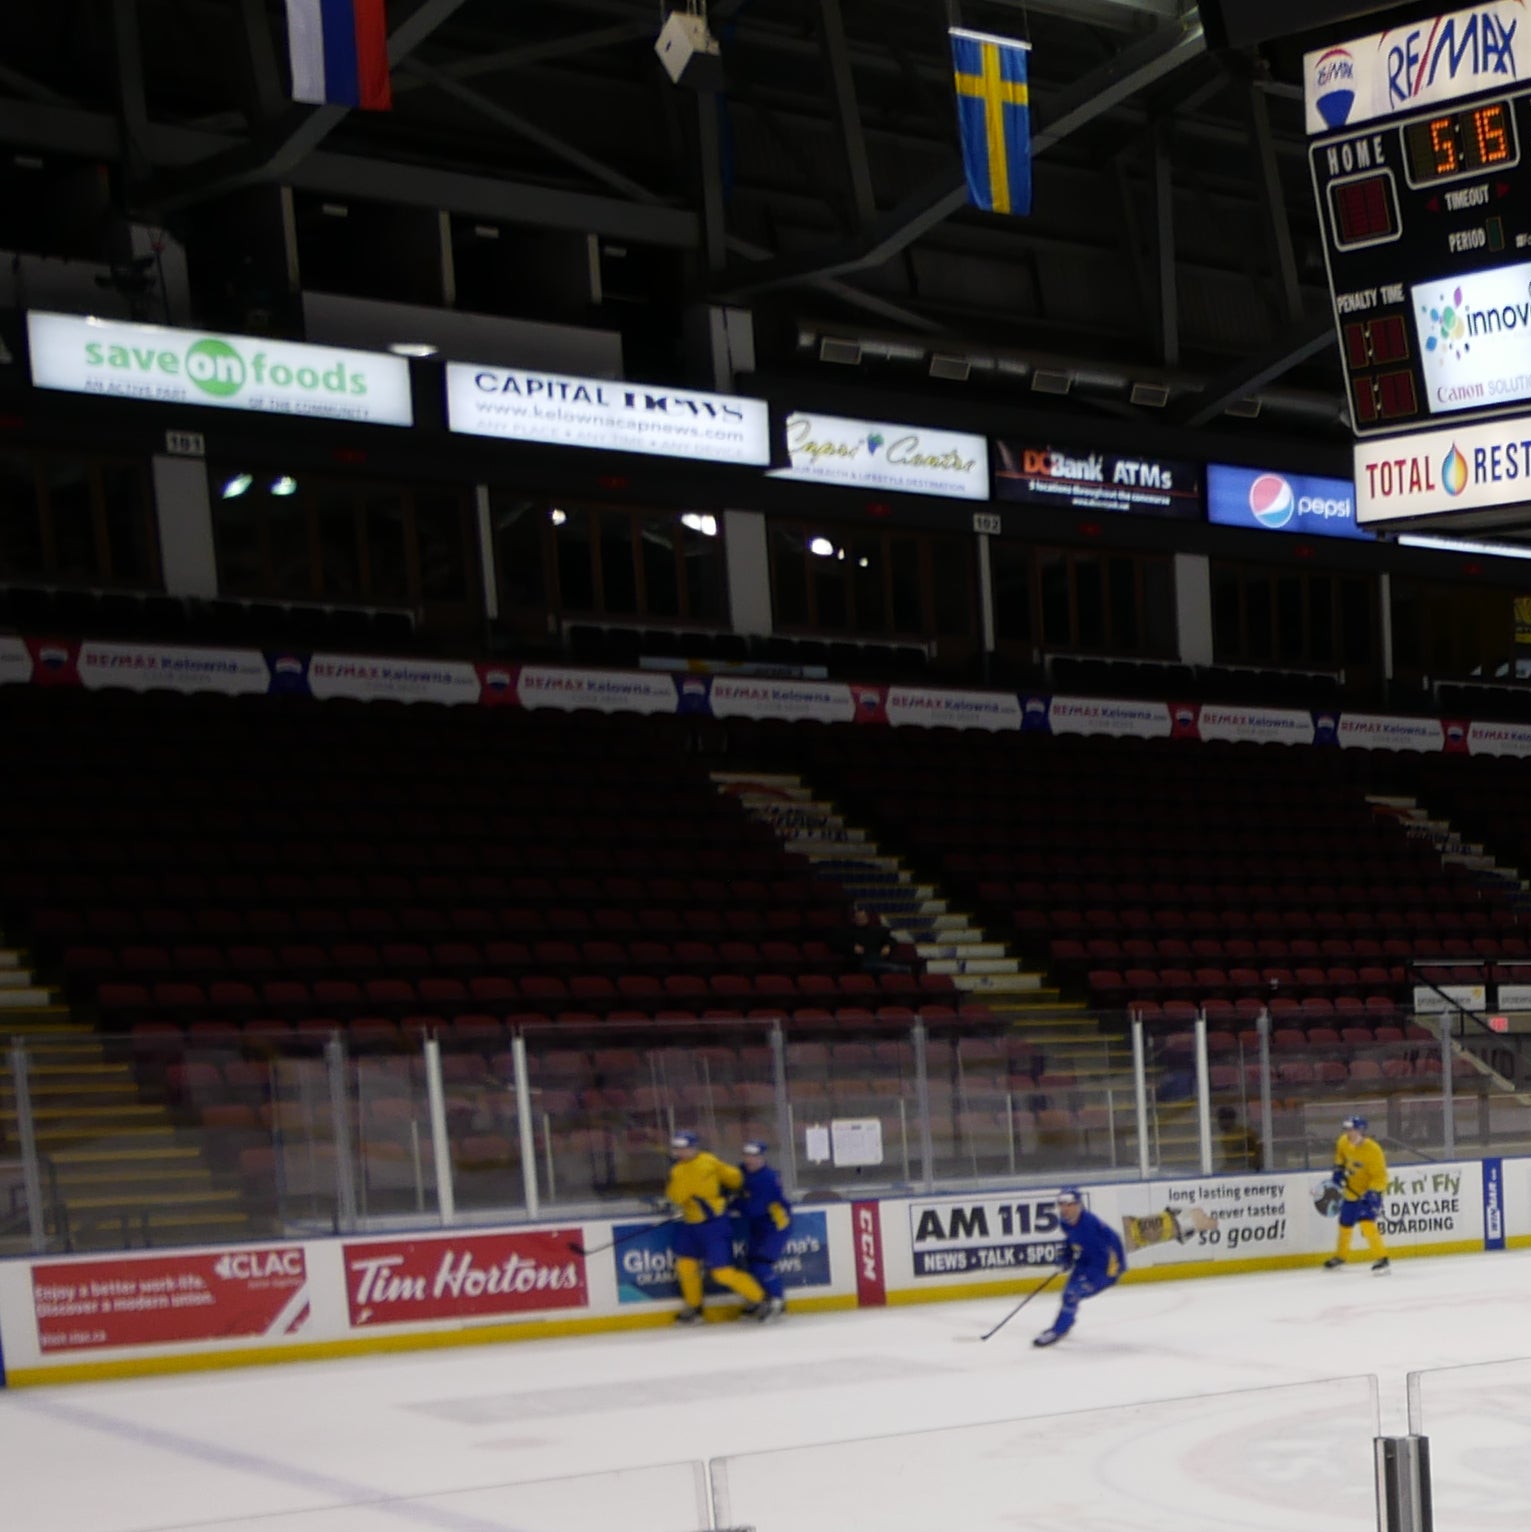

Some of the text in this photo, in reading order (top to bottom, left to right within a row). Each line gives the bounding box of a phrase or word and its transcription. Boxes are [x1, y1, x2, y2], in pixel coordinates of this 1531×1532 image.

[1388, 12, 1517, 110] RE/MAX
[1327, 135, 1386, 176] HOME
[1444, 185, 1489, 211] TIMEOUT
[1448, 227, 1485, 253] PERIOD
[1336, 283, 1405, 314] PENALTY TIME
[85, 341, 368, 395] save on foods
[474, 372, 609, 408] CAPITAL
[1437, 382, 1484, 404] Canon
[1366, 455, 1435, 499] TOTAL
[1297, 495, 1351, 520] pepsi
[1168, 1183, 1286, 1204] long lasting energy
[1432, 1171, 1461, 1198] Fly
[915, 1205, 990, 1243] AM
[1210, 1202, 1286, 1220] never tasted
[1376, 1216, 1455, 1236] BOARDING
[1198, 1219, 1287, 1249] so good!
[231, 1249, 302, 1279] CLAC
[923, 1247, 1016, 1272] NEWS TALK
[351, 1248, 579, 1305] Tim Hortons
